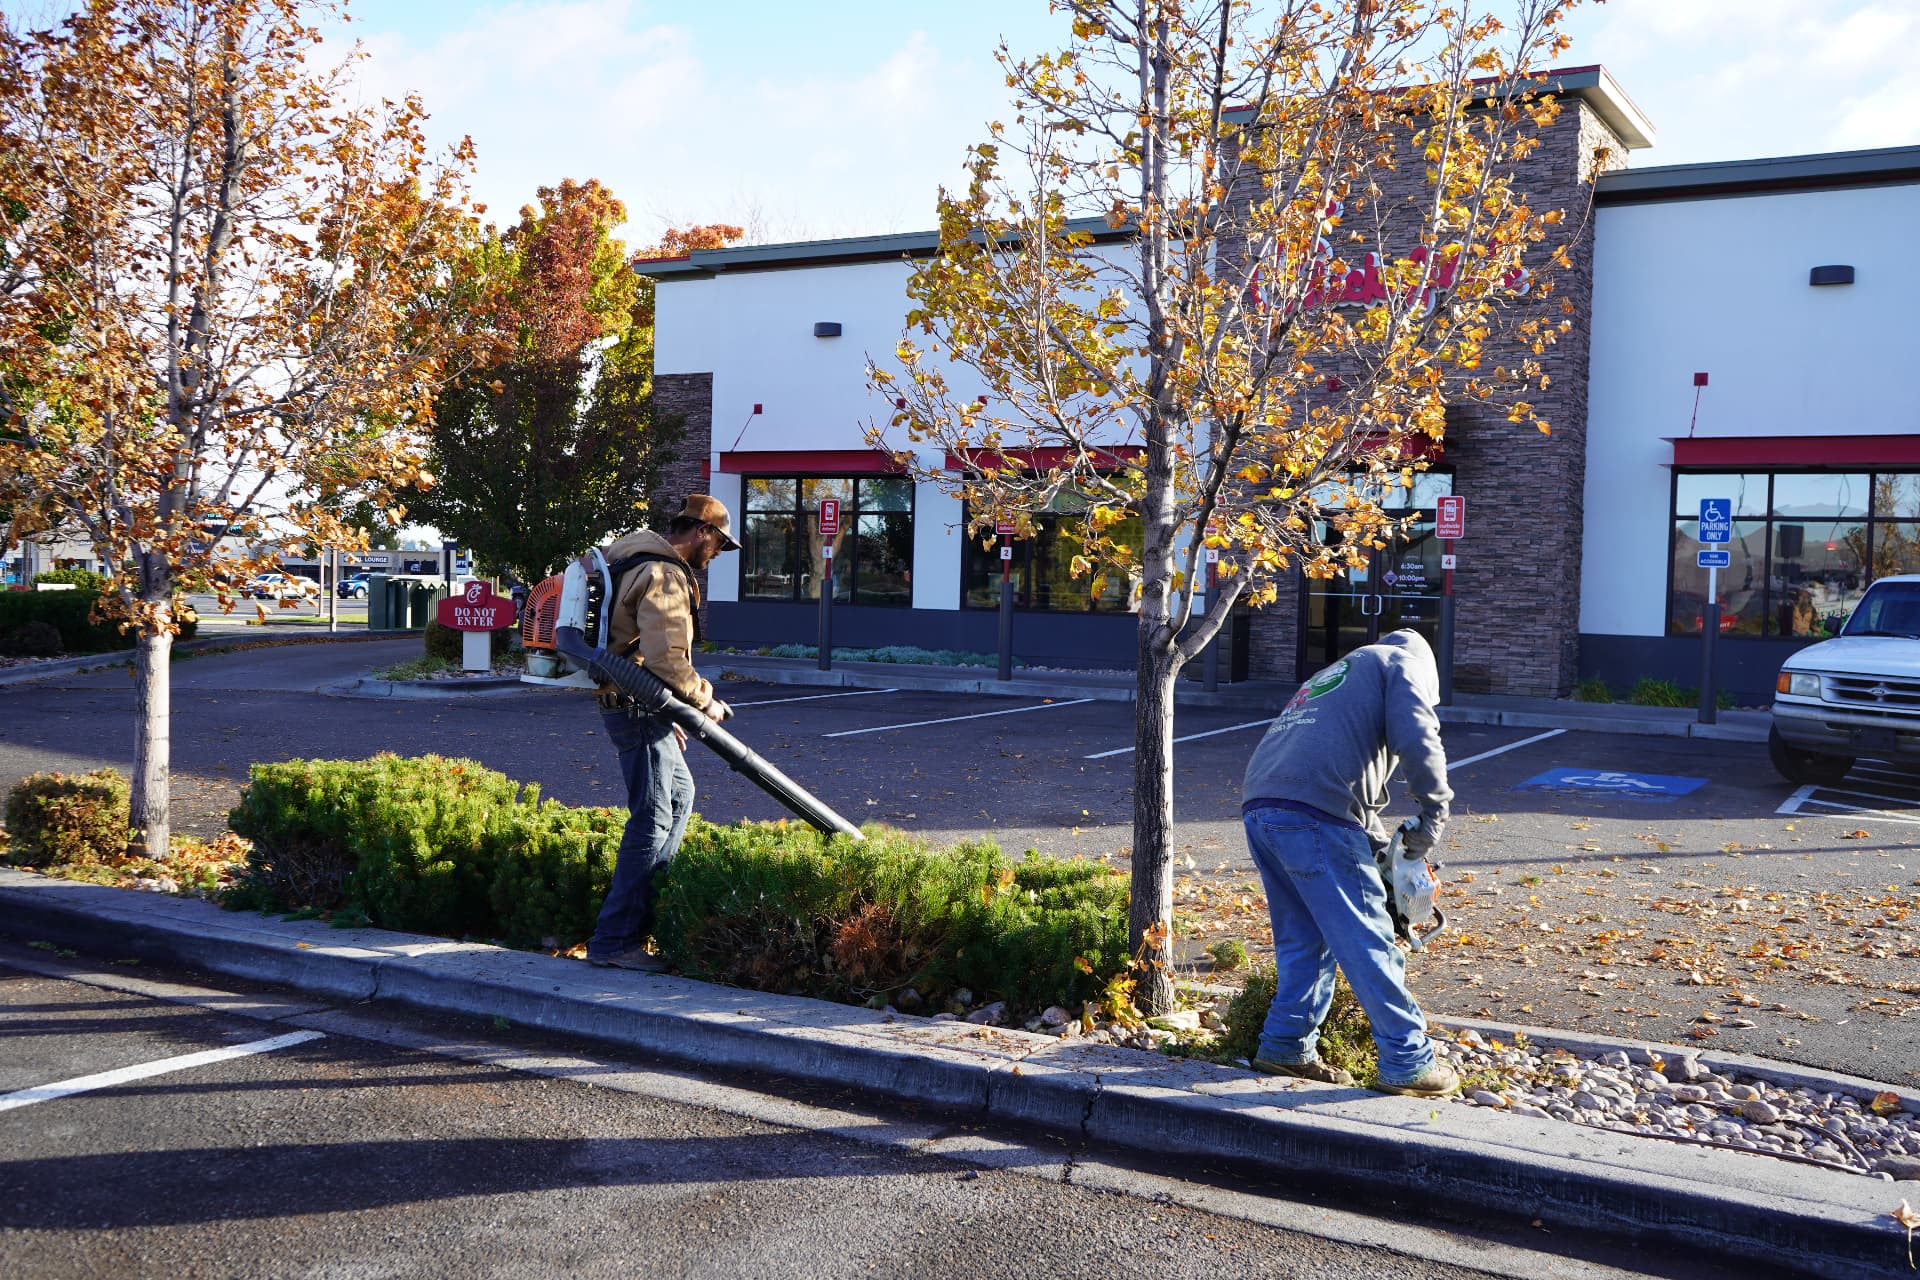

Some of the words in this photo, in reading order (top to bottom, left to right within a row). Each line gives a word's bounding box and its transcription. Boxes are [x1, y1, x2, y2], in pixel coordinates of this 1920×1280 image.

[1701, 522, 1729, 531] PARKING
[1706, 532, 1723, 540] ONLY
[454, 607, 471, 617] DO
[473, 607, 497, 618] NOT
[457, 617, 494, 626] ENTER
